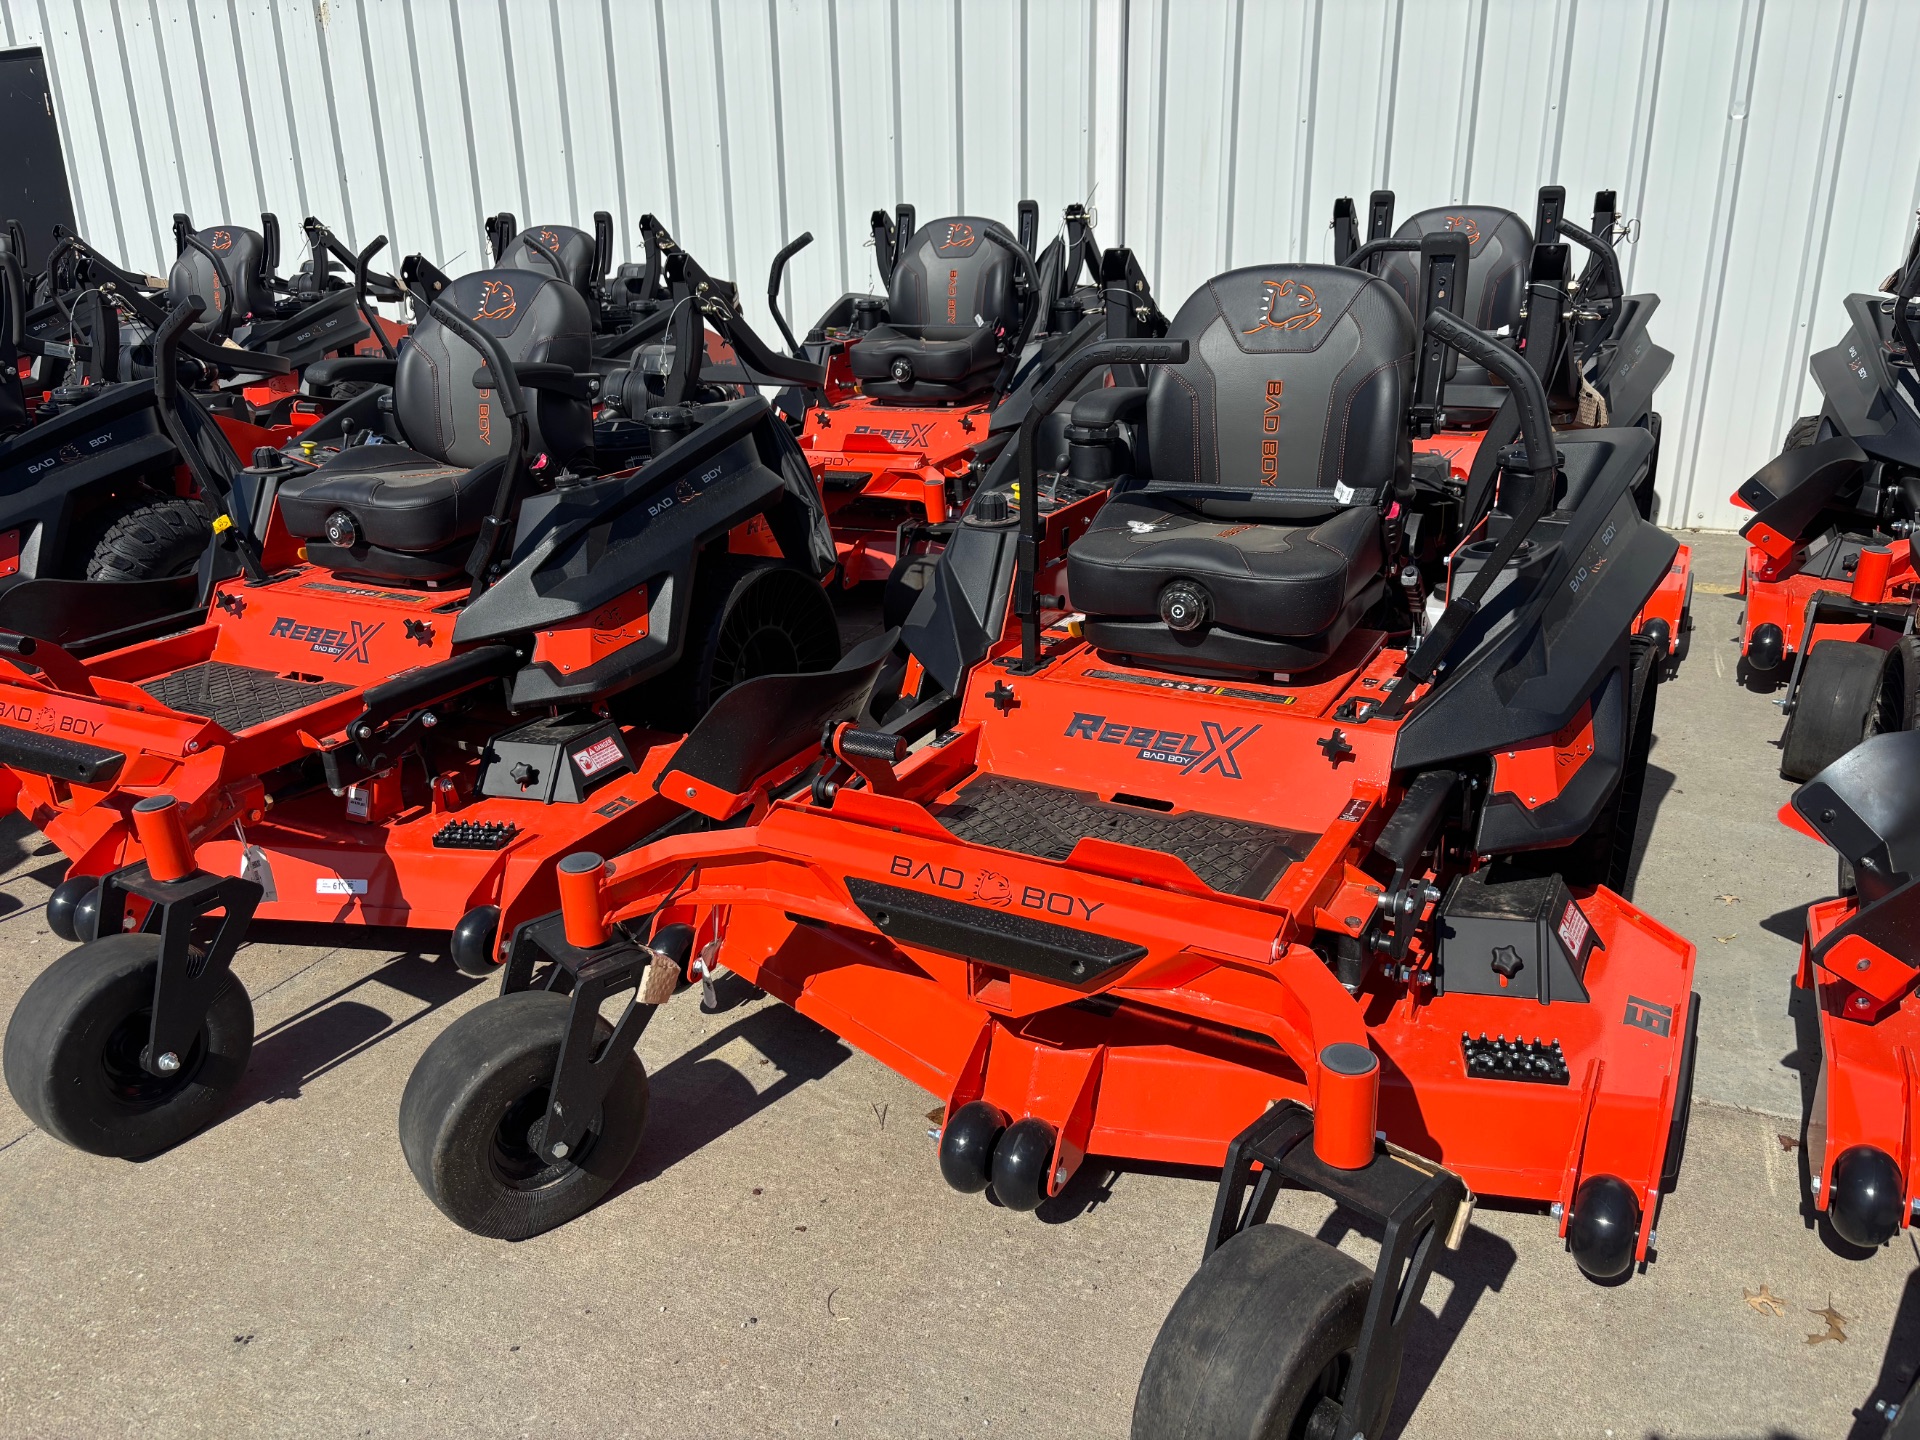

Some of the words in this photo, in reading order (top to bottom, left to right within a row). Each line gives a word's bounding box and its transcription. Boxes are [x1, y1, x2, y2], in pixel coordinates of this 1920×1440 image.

[946, 270, 958, 297] BAD
[946, 299, 957, 324] BOY
[297, 332, 311, 342] BAD
[1114, 345, 1172, 360] BAD
[478, 403, 491, 446] BOY
[1264, 379, 1284, 435] BAD
[28, 458, 55, 474] BAD
[89, 432, 113, 448] BOY
[823, 457, 855, 467] BOY
[1260, 439, 1279, 487] BOY
[648, 497, 674, 517] BAD
[701, 465, 722, 484] BOY
[1569, 567, 1588, 593] BAD
[1601, 521, 1617, 546] BOY
[327, 646, 342, 654] BOY
[0, 702, 33, 722] BAD
[60, 715, 104, 737] BOY
[1142, 751, 1165, 761] BAD
[1168, 754, 1190, 765] BOY
[890, 855, 965, 890] BAD
[1020, 885, 1105, 921] BOY
[1622, 994, 1673, 1038] 61
